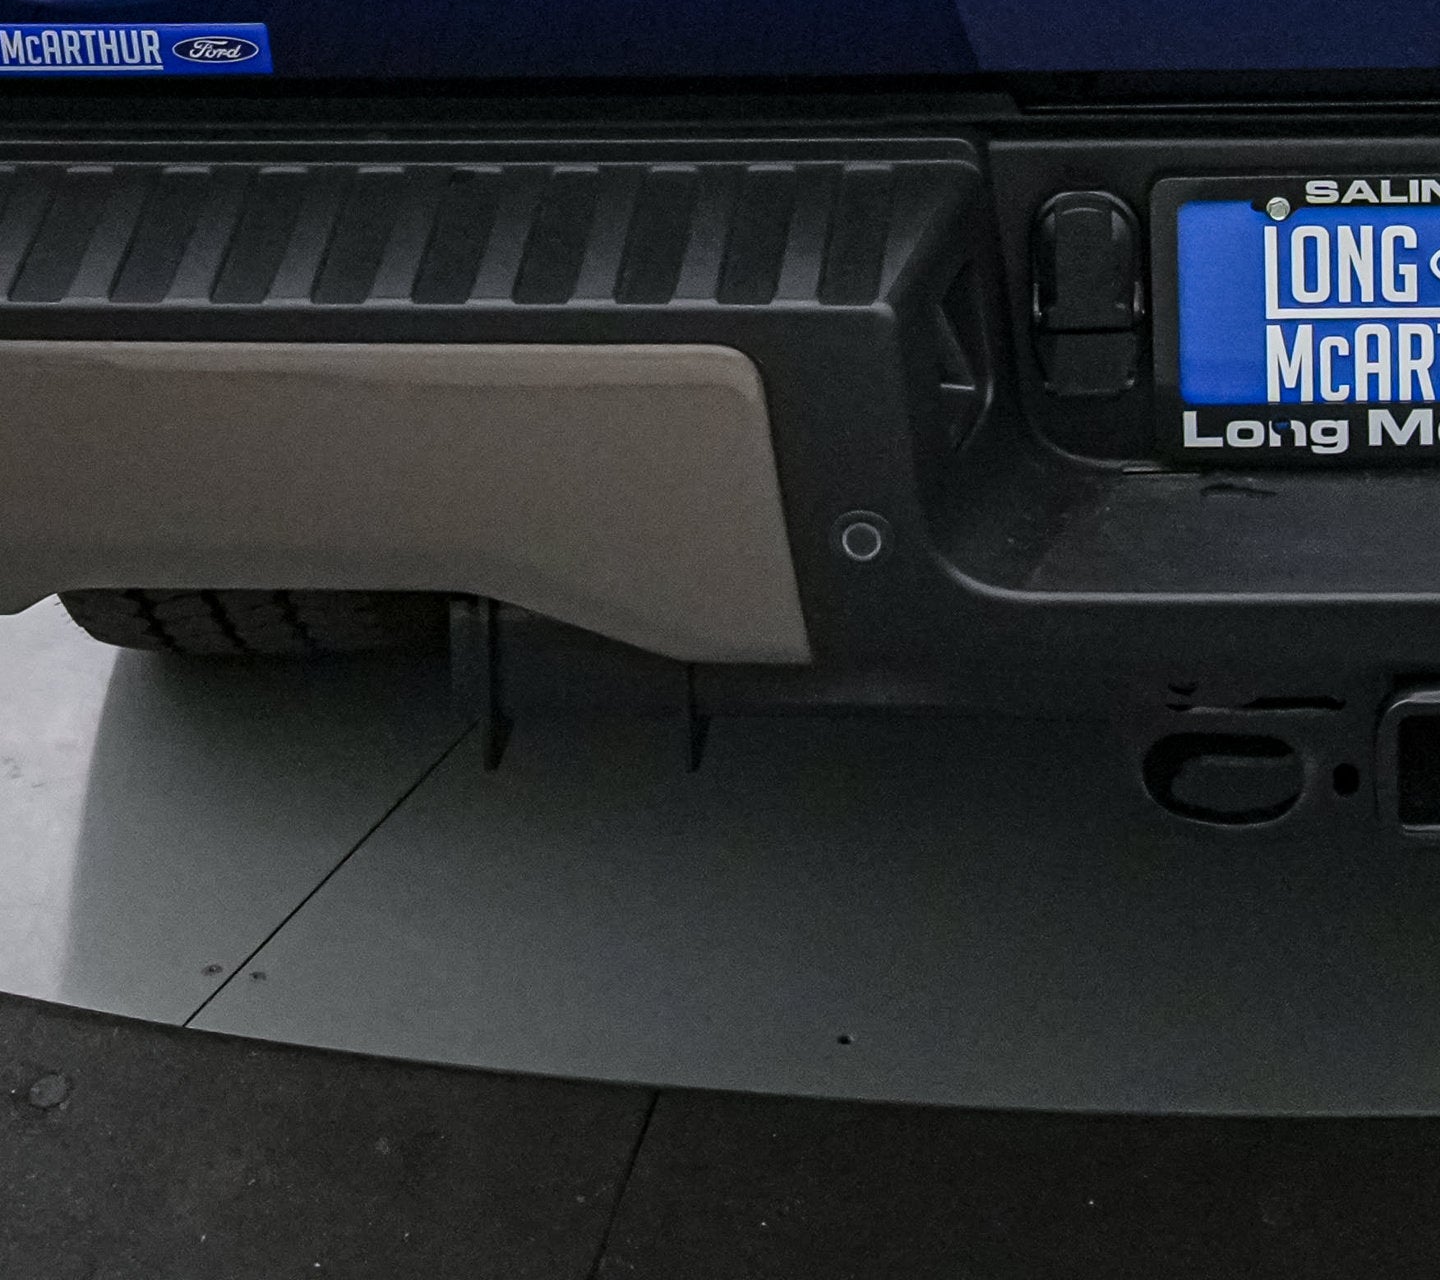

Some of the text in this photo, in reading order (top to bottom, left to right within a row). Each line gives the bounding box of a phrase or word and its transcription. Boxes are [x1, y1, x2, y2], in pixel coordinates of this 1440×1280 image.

[0, 28, 163, 66] McARTHUR
[188, 39, 242, 61] Ford
[1264, 225, 1419, 310] LONG
[1182, 410, 1350, 455] Long
